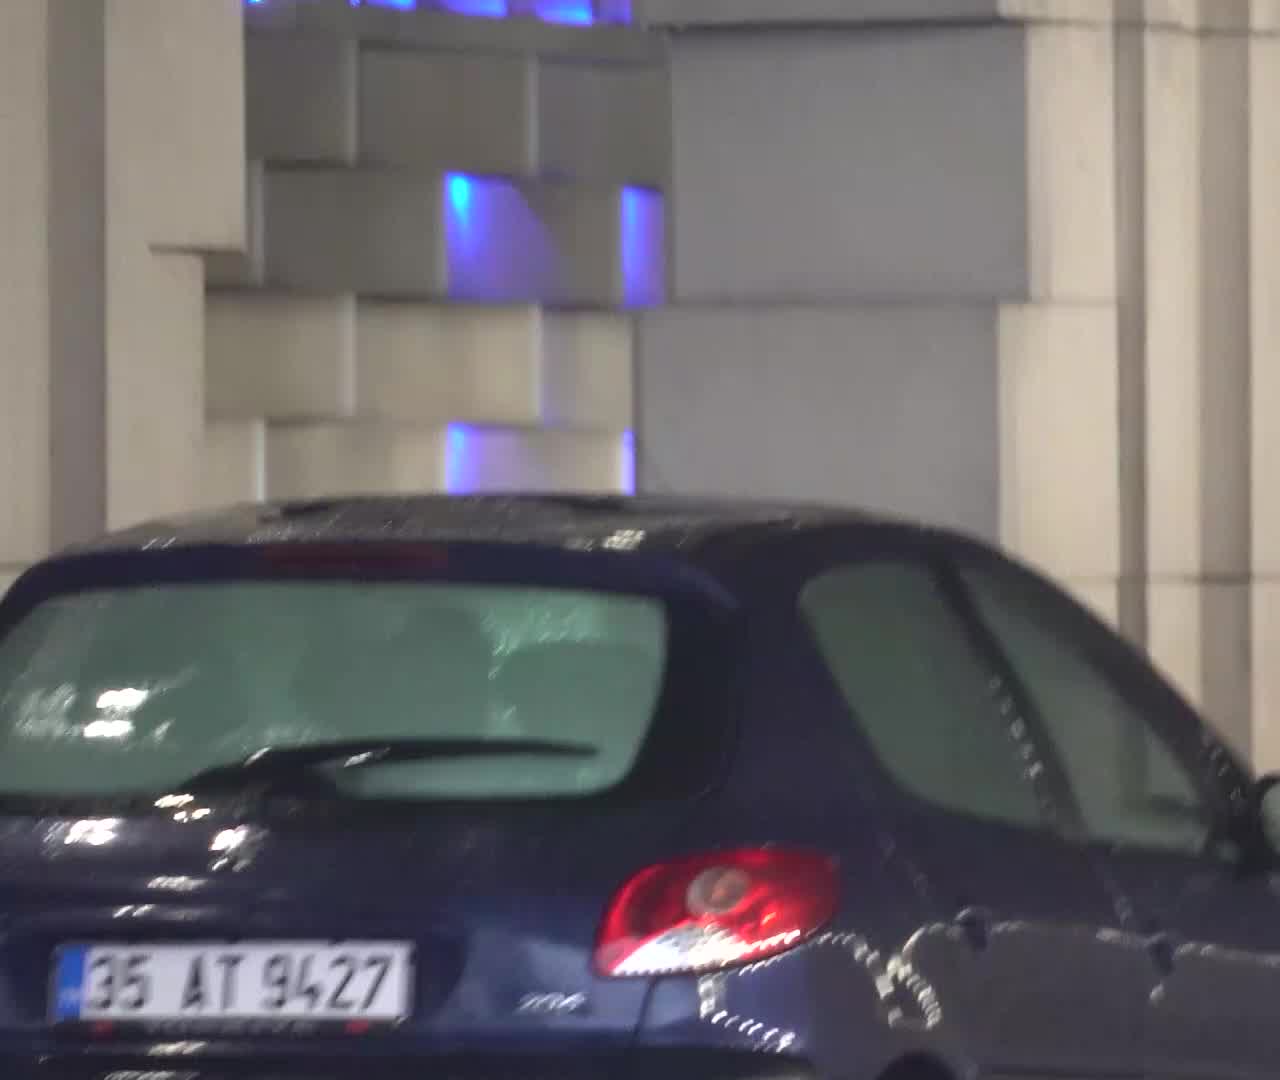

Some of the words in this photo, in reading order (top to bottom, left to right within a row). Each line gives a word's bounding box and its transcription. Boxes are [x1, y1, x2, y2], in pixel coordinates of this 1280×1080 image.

[88, 953, 153, 1010] 35
[180, 954, 246, 1011] AT
[262, 953, 394, 1011] 9427
